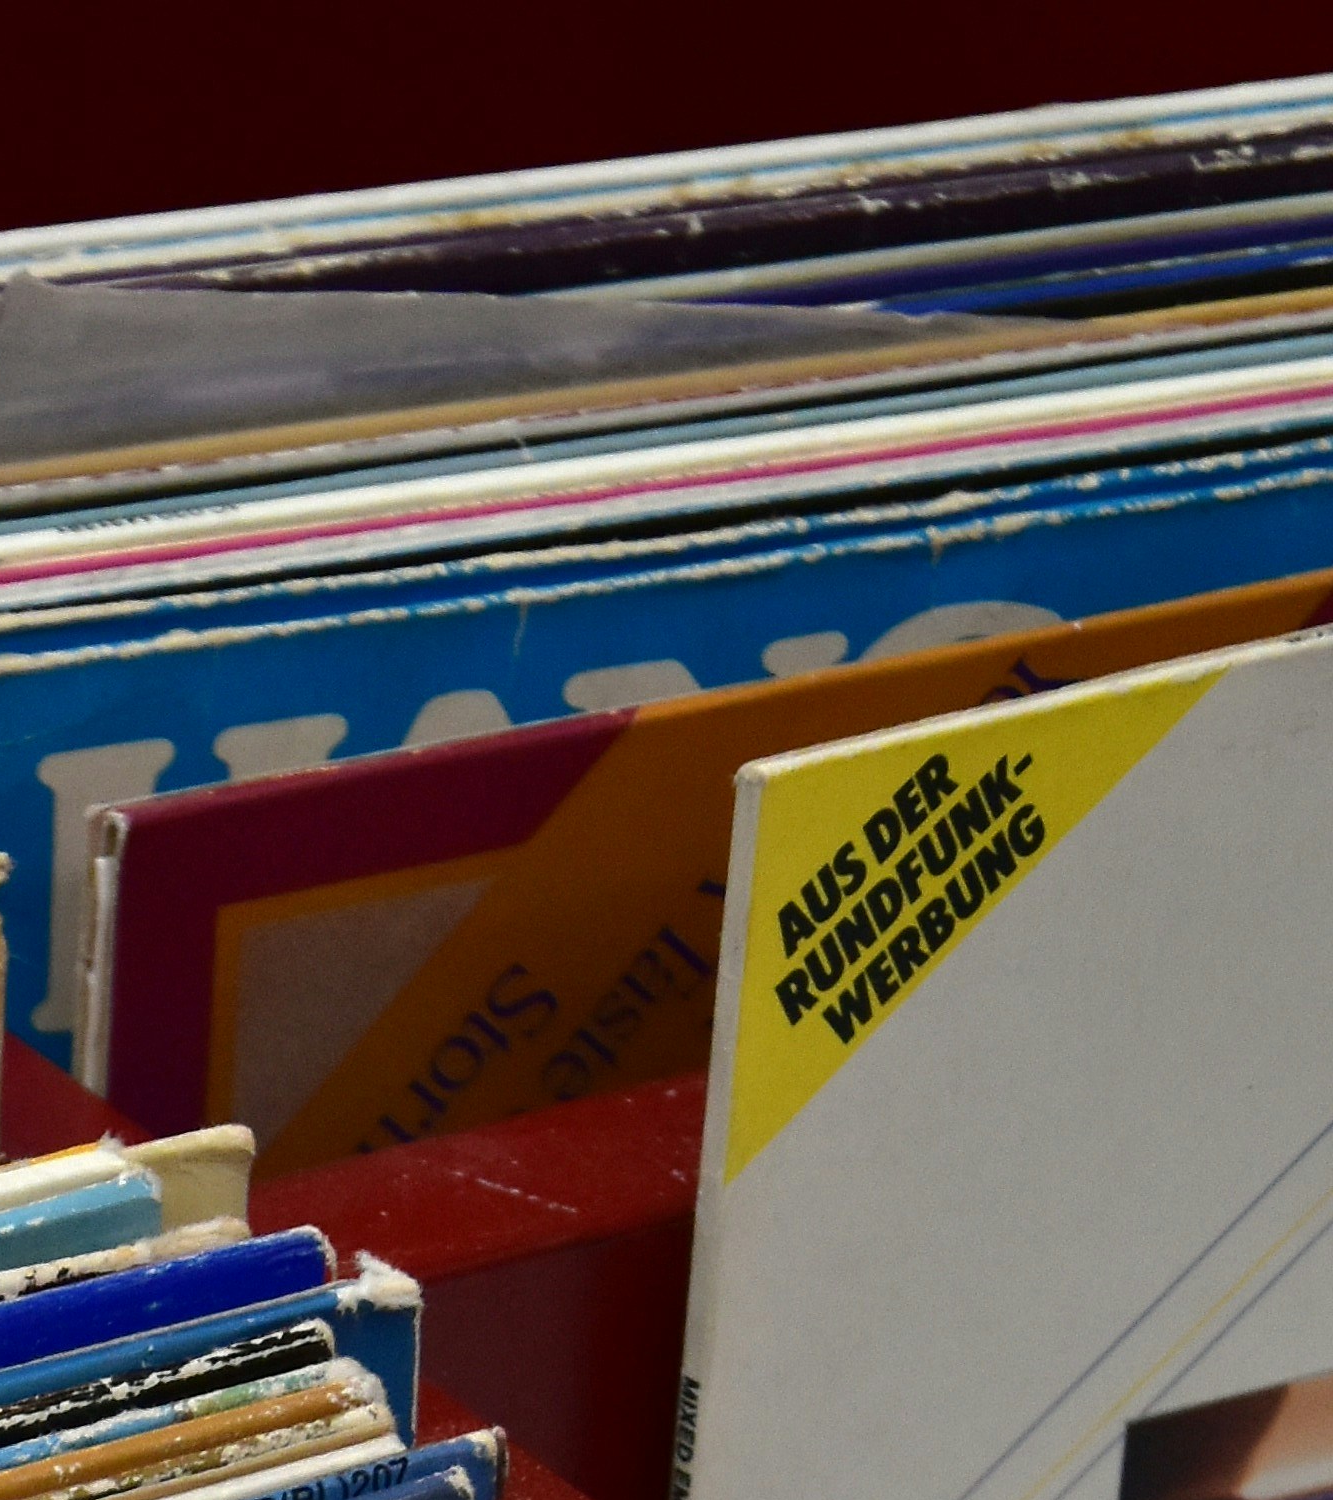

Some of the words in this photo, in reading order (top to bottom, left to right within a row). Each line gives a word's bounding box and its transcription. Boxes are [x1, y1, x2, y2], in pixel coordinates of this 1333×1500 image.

[774, 752, 1035, 1027] RUNDFUNK-
[776, 840, 868, 960] AUS
[861, 752, 960, 866] DER
[820, 803, 1047, 1047] WERBUNG
